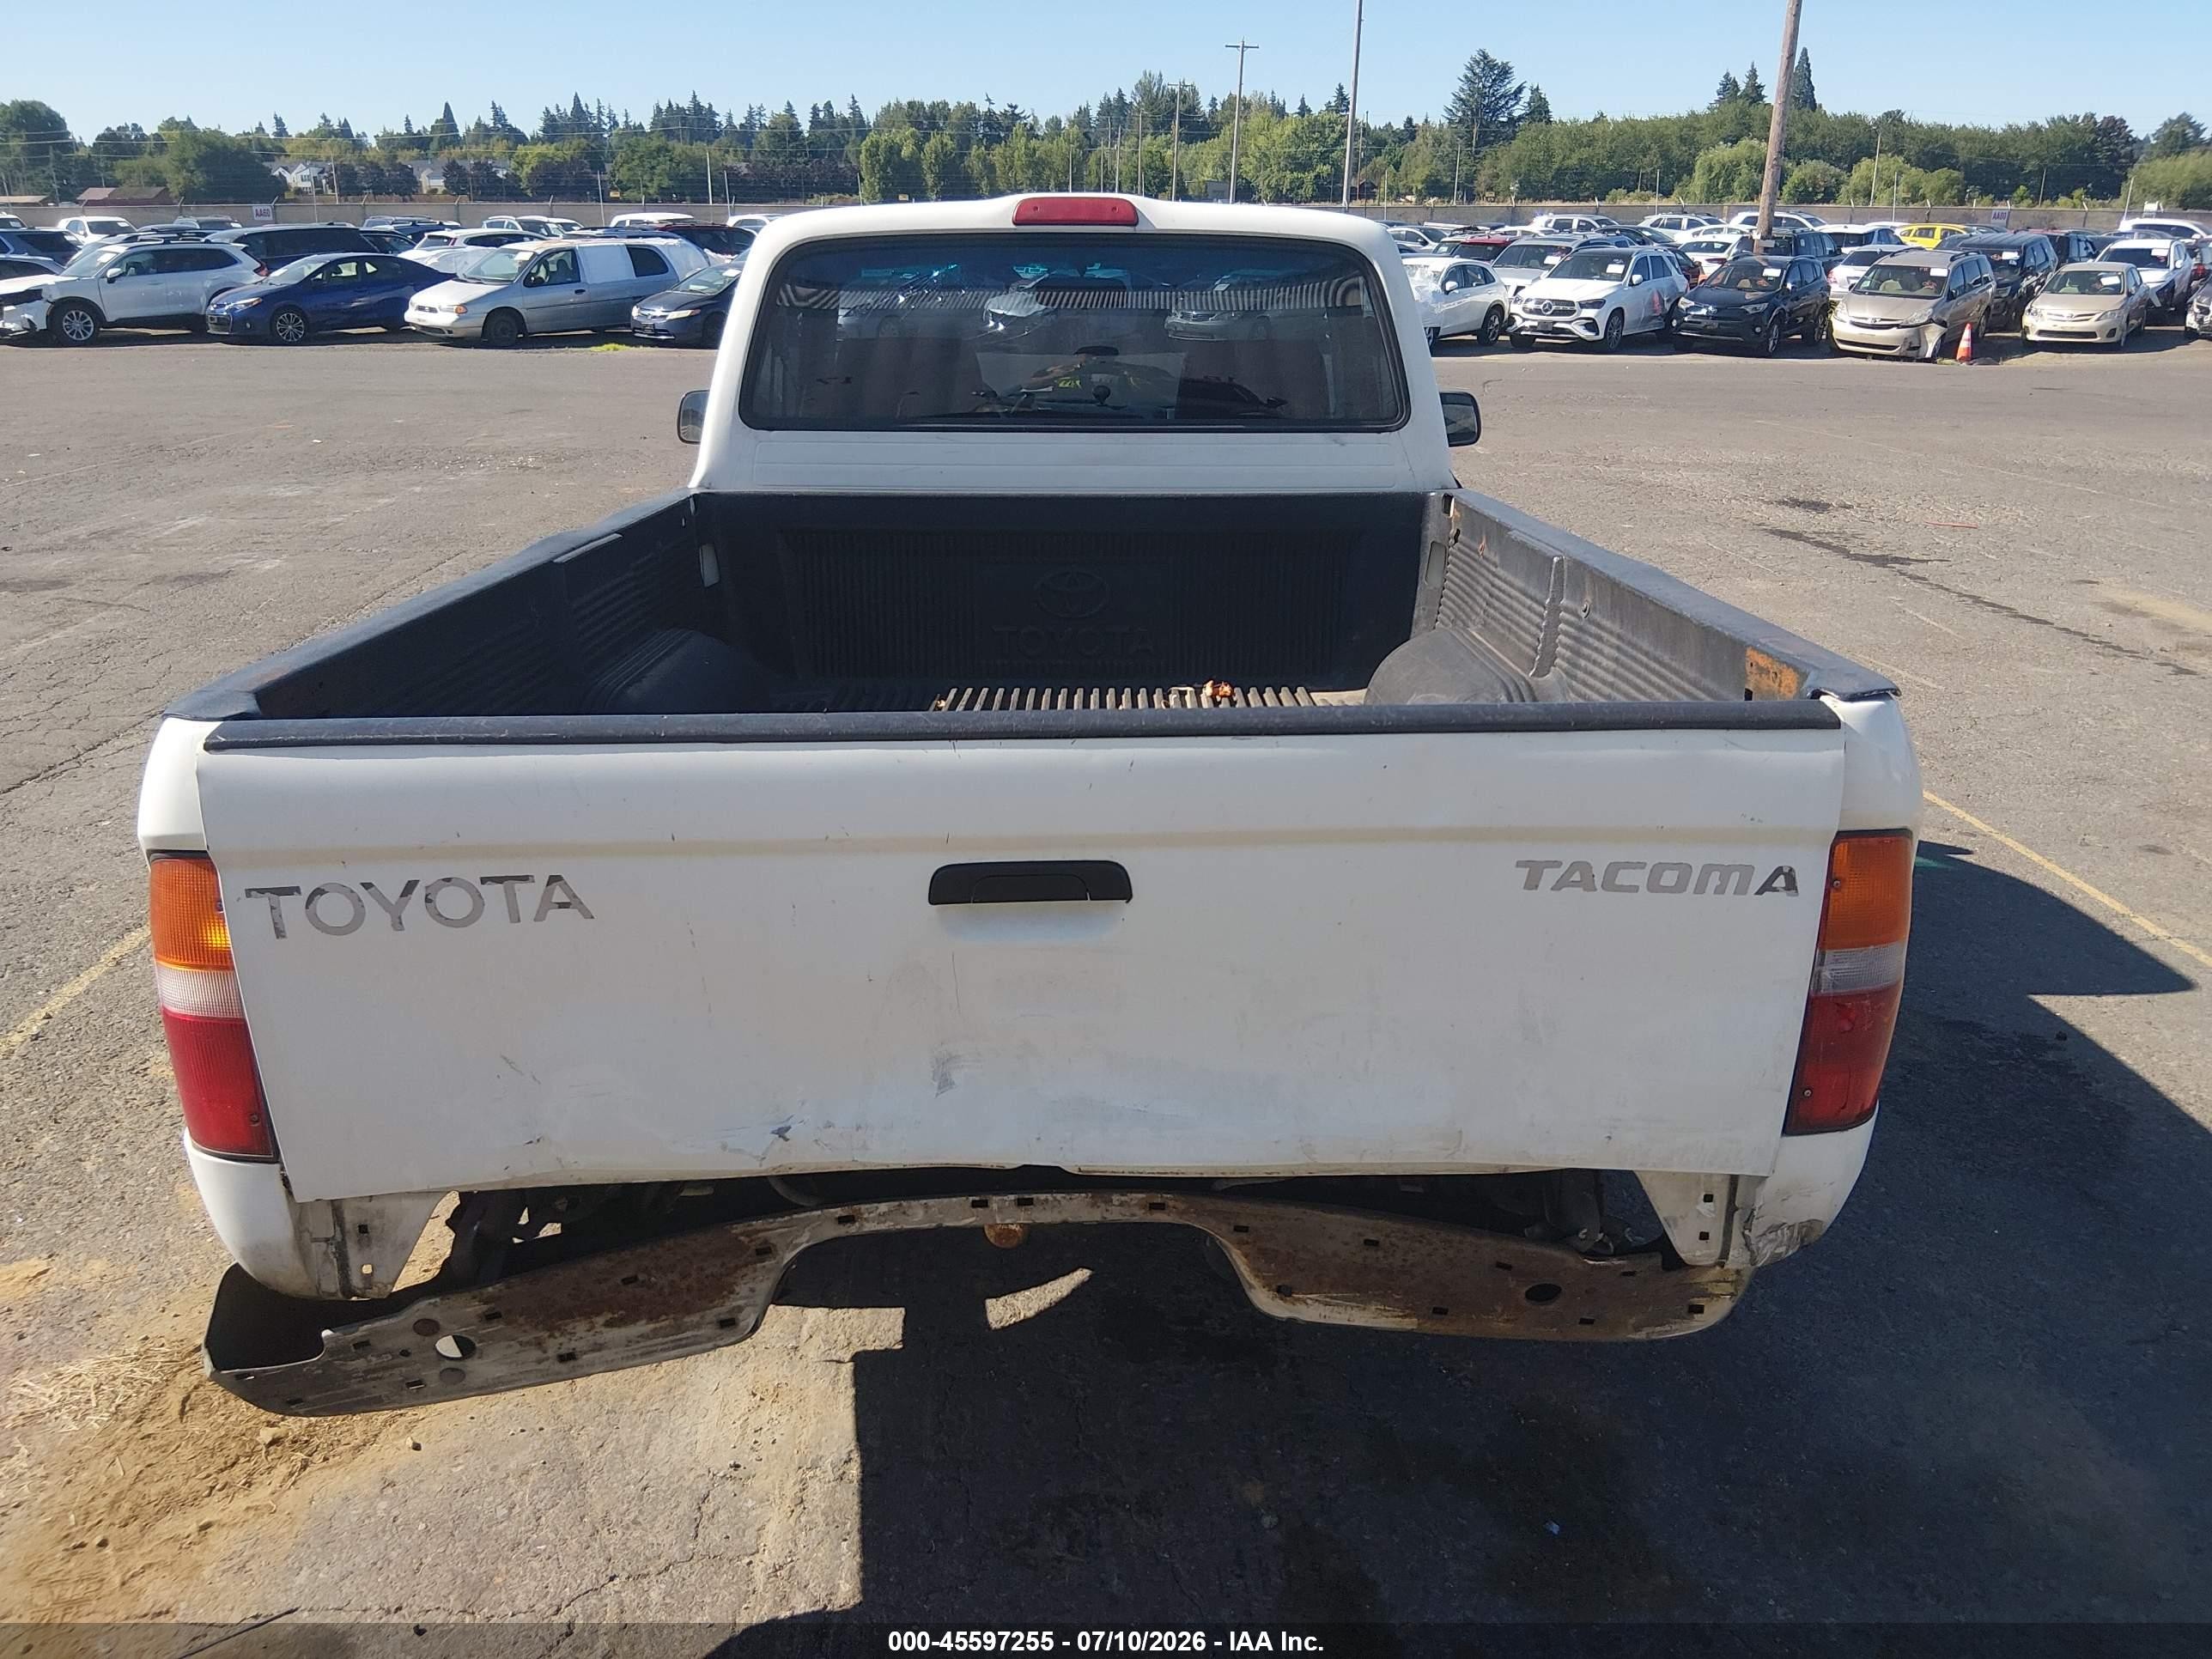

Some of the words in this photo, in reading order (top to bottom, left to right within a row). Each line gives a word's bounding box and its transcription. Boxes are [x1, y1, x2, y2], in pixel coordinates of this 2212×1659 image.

[991, 625, 1156, 657] TOYOTA
[1516, 860, 1799, 896] TACOMA
[245, 874, 594, 939] TOYOTA
